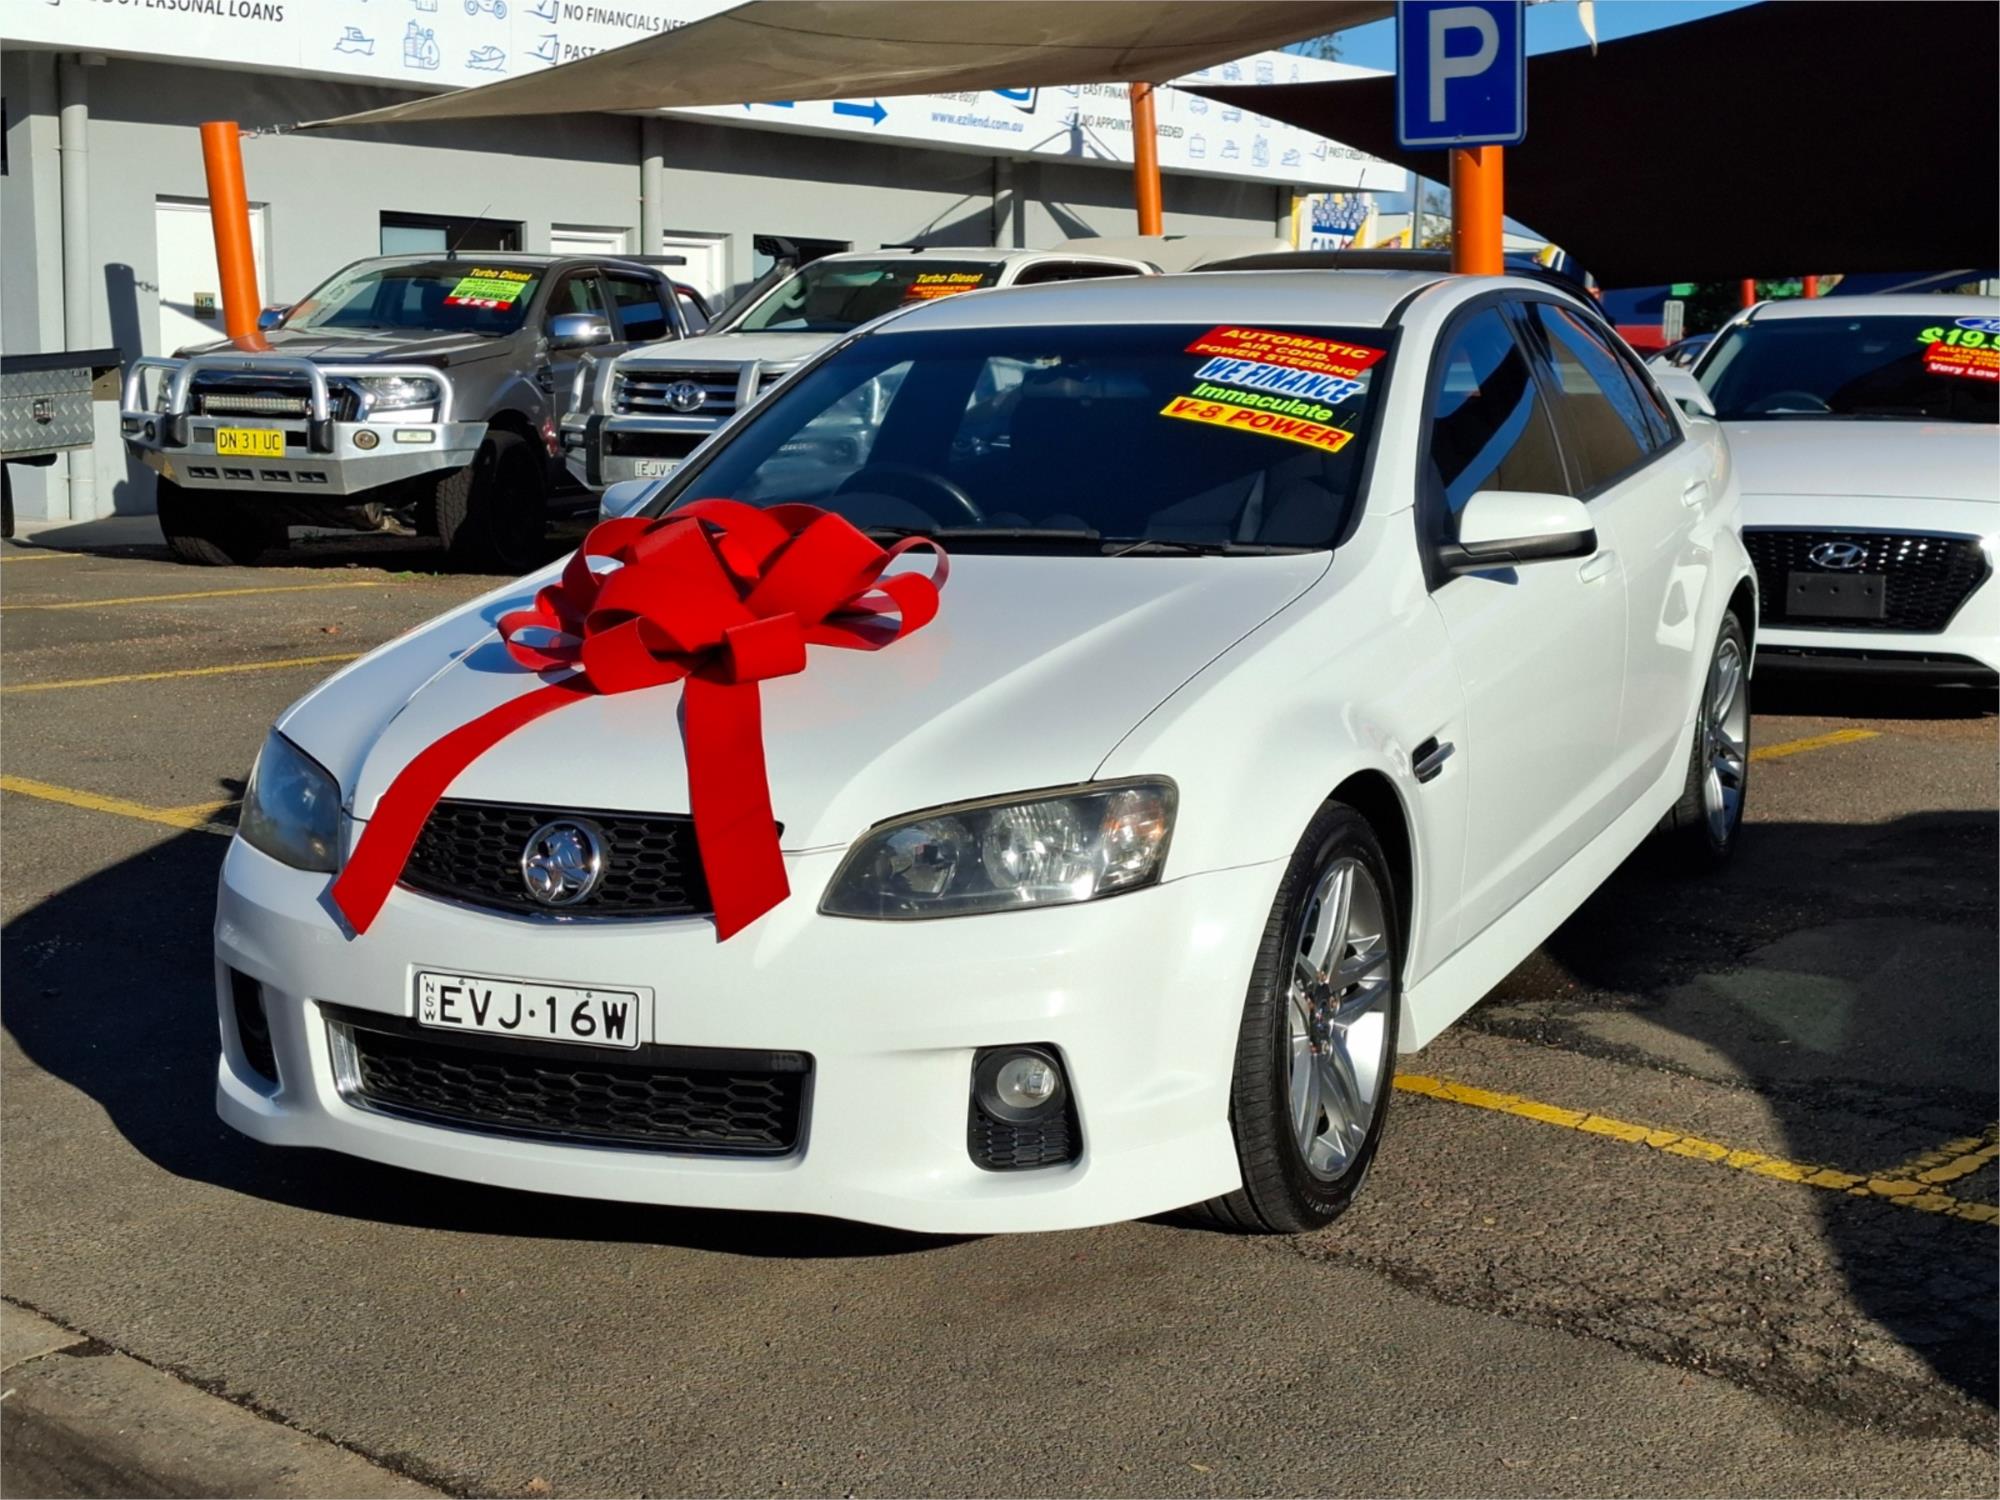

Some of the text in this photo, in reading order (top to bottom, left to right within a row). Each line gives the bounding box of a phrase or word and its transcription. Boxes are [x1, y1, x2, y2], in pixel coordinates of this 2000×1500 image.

[228, 1, 284, 22] LOANS
[563, 4, 584, 21] NO
[586, 8, 660, 32] FINANCIALS
[1429, 6, 1499, 122] P
[931, 111, 1024, 132] www.ezilend.com.au
[1157, 124, 1184, 139] EEDED
[470, 268, 533, 281] Turbo Diesel
[916, 273, 983, 284] Turbo Diesel
[1221, 329, 1370, 359] AUTOMATIC
[1239, 341, 1330, 362] AIR COND.
[1196, 343, 1359, 377] POWER STEERING
[1929, 362, 1999, 378] Very Low
[1200, 357, 1361, 403] WE FINANCE
[1192, 382, 1333, 421] Immaculate
[1170, 399, 1345, 446] V-8 POWER
[219, 432, 281, 451] DN 31 UC
